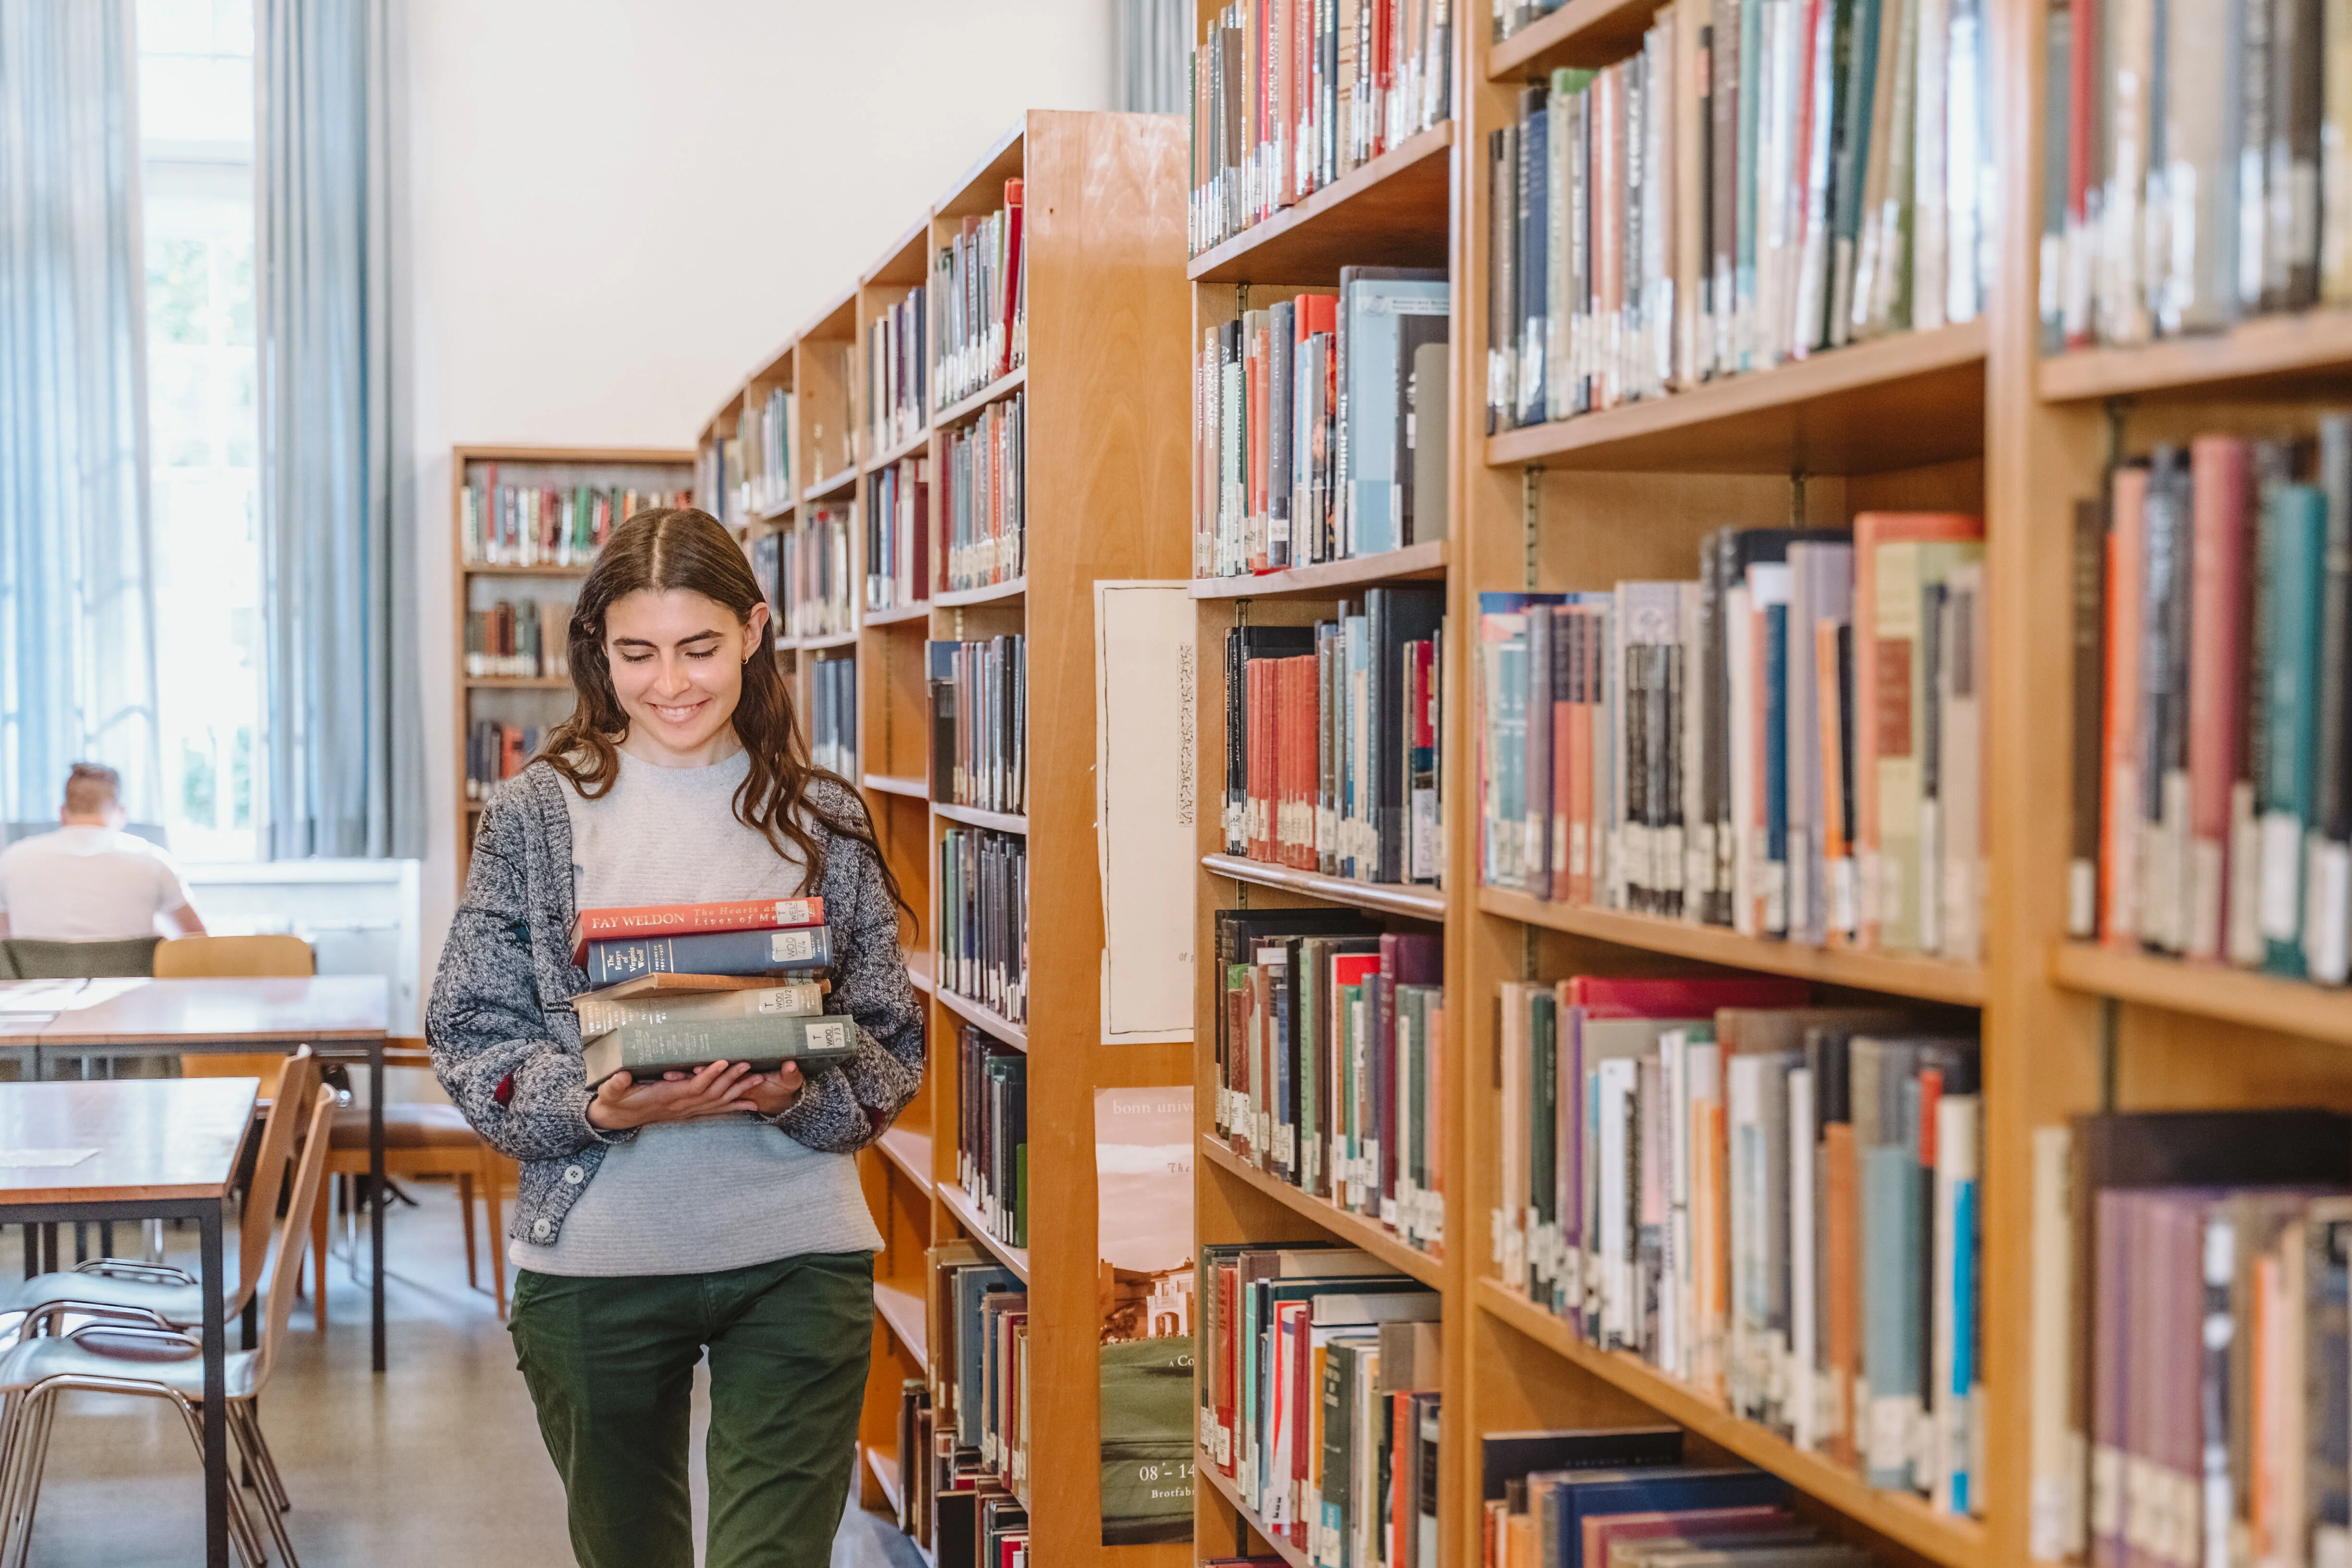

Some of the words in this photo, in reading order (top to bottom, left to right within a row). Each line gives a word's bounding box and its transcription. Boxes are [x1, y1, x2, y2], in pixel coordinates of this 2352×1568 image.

[693, 908, 714, 916] The
[719, 906, 758, 915] Hearts
[592, 917, 619, 929] FAY
[622, 913, 684, 927] WELDON
[694, 917, 732, 926] Lives
[739, 914, 754, 924] of
[786, 937, 795, 959] WOO
[797, 941, 806, 954] 4/4
[615, 951, 623, 971] Essays
[628, 947, 637, 973] Virginia
[637, 949, 645, 969] Woolf
[1113, 1100, 1151, 1114] bonn
[1168, 1163, 1190, 1173] The
[1139, 1466, 1158, 1481] 08
